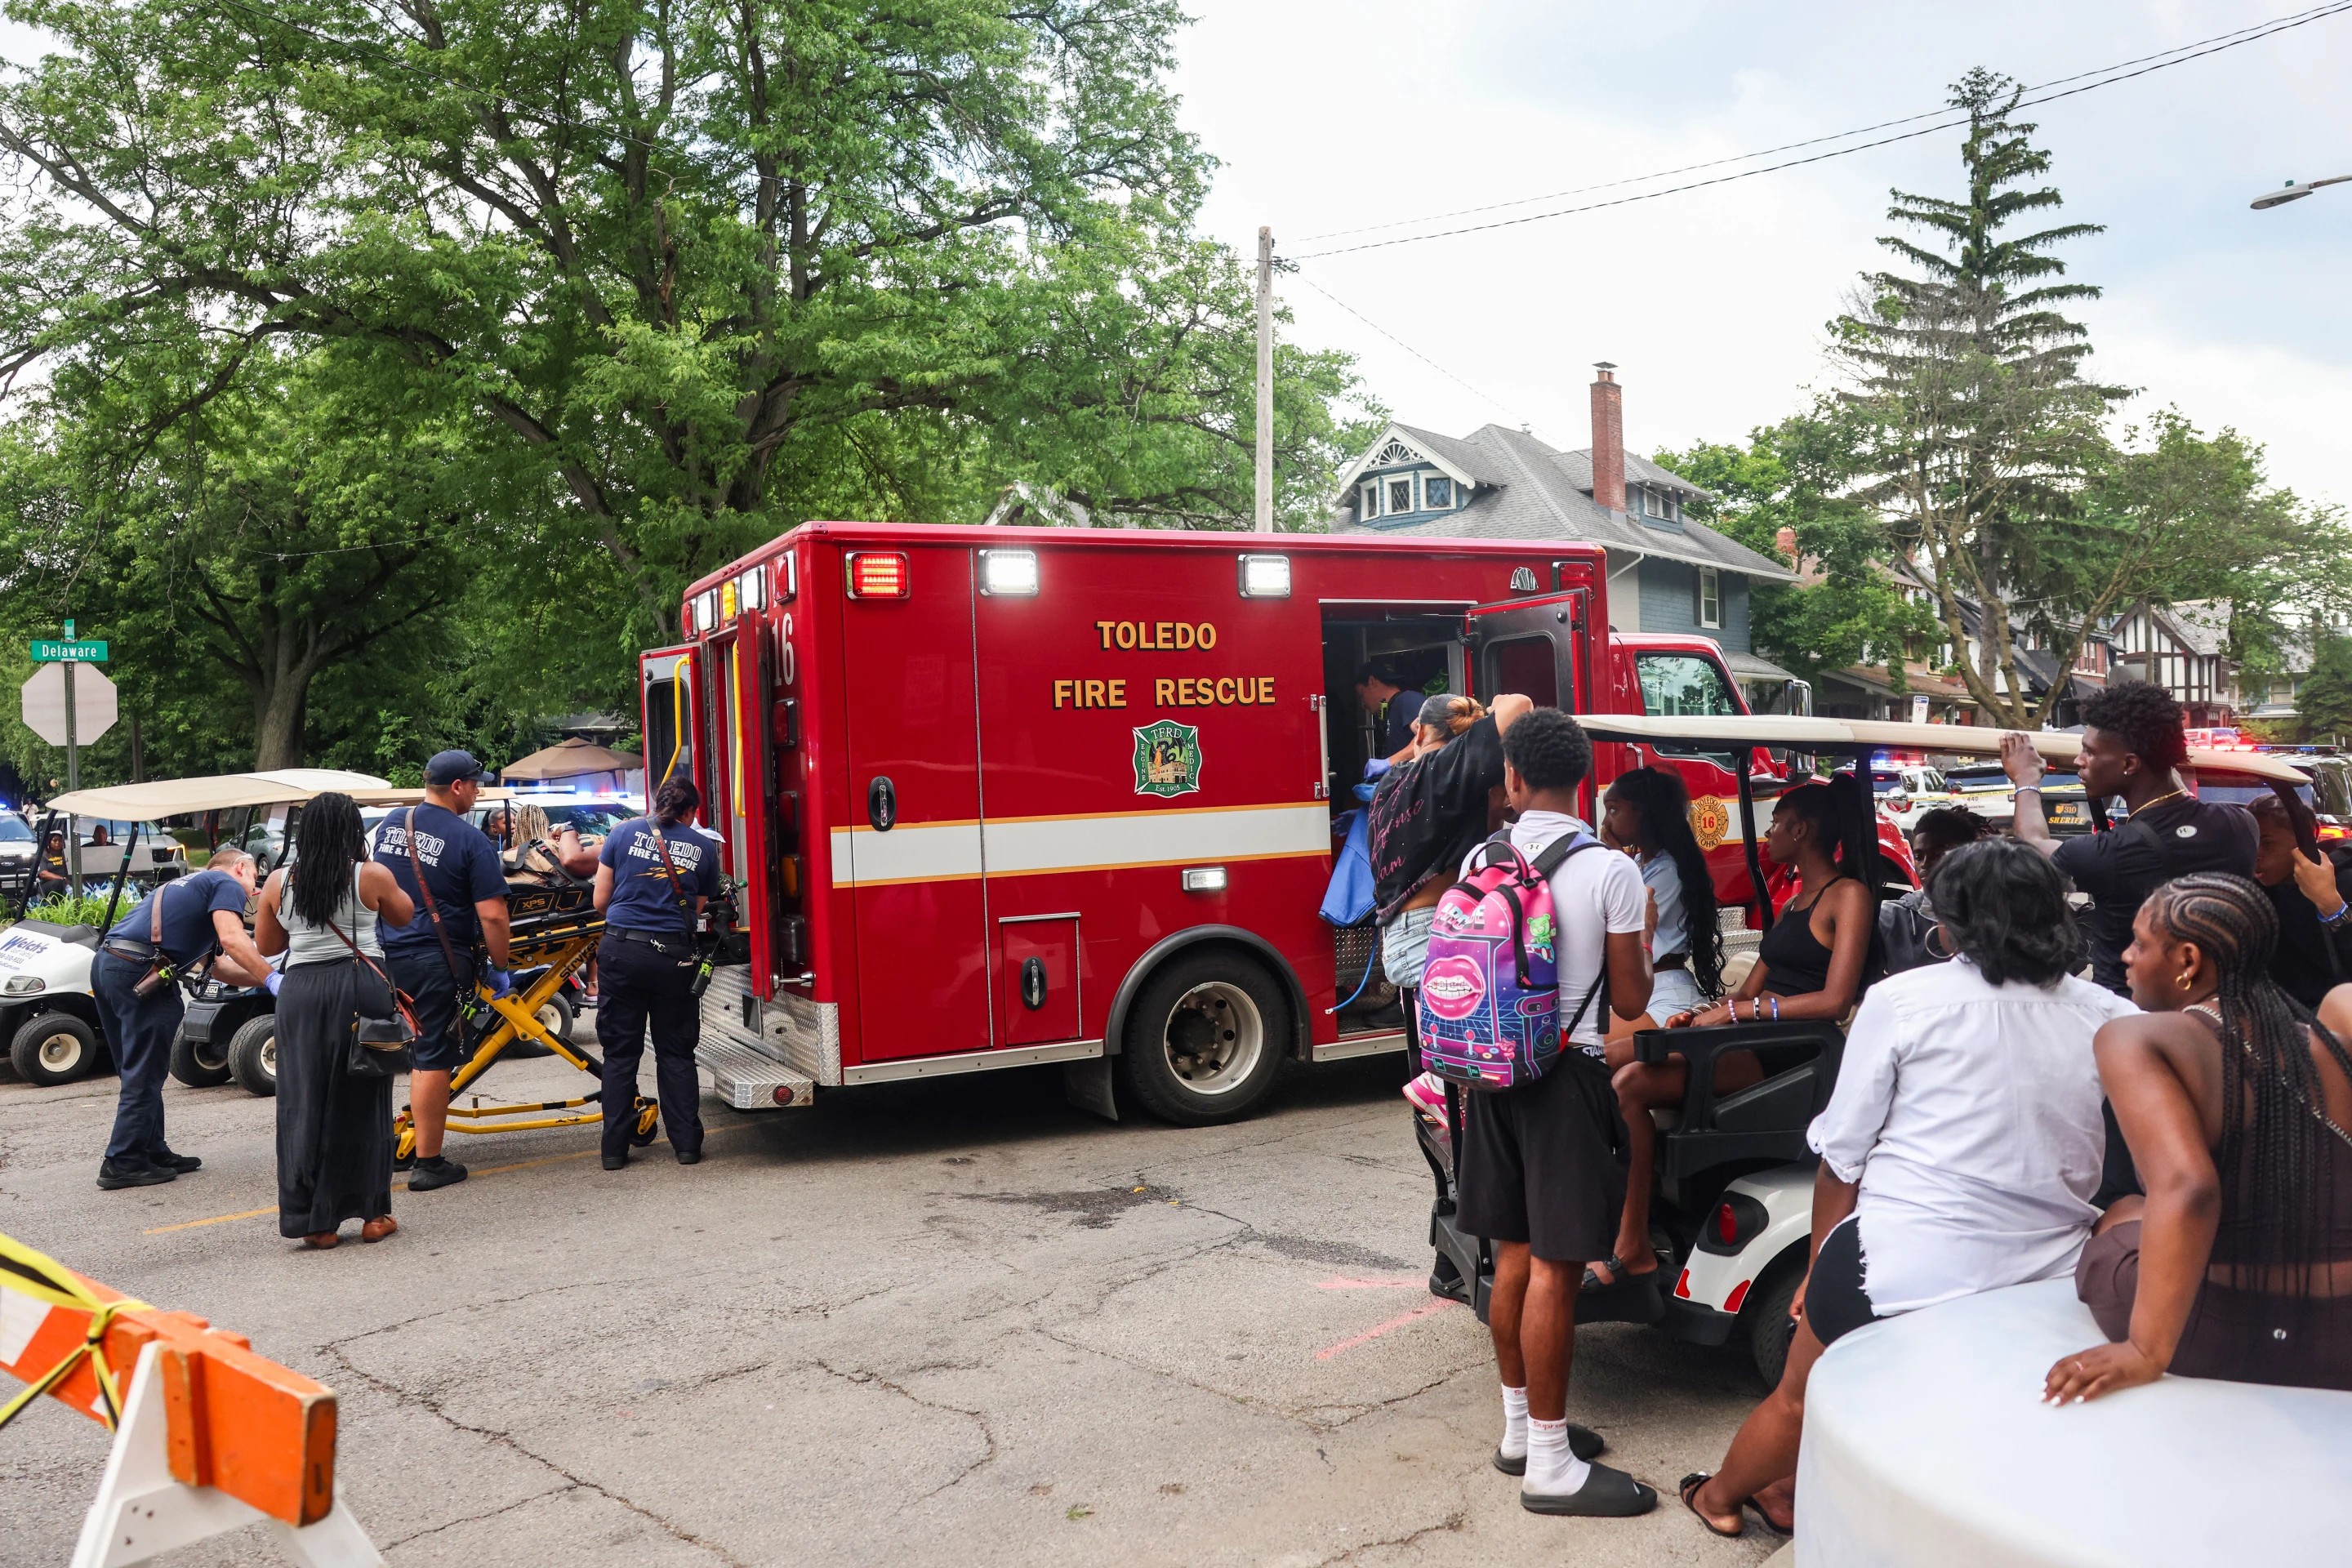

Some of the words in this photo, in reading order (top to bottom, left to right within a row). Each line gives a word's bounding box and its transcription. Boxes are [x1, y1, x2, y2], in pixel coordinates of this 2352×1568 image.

[1095, 621, 1217, 651] TOLEDO
[42, 644, 96, 657] Delaware
[772, 612, 795, 686] 16
[1053, 679, 1127, 710] FIRE
[1154, 676, 1276, 707] RESCUE
[1151, 727, 1183, 740] TFRD
[1697, 797, 1718, 808] TOLEDO
[2064, 806, 2078, 814] 310
[1703, 816, 1714, 829] 16
[2048, 817, 2086, 825] SHERIFF
[635, 831, 702, 862] TOEDO
[1701, 839, 1718, 848] OHIO
[379, 844, 394, 853] FIRE
[394, 847, 402, 855] &
[404, 850, 439, 867] RSCUE
[628, 846, 651, 859] FIRE
[652, 854, 661, 862] &
[662, 855, 697, 871] SCUE
[523, 898, 545, 908] XPS
[1435, 902, 1486, 932] ARCE
[0, 936, 50, 954] Welch's
[560, 937, 600, 982] stryker
